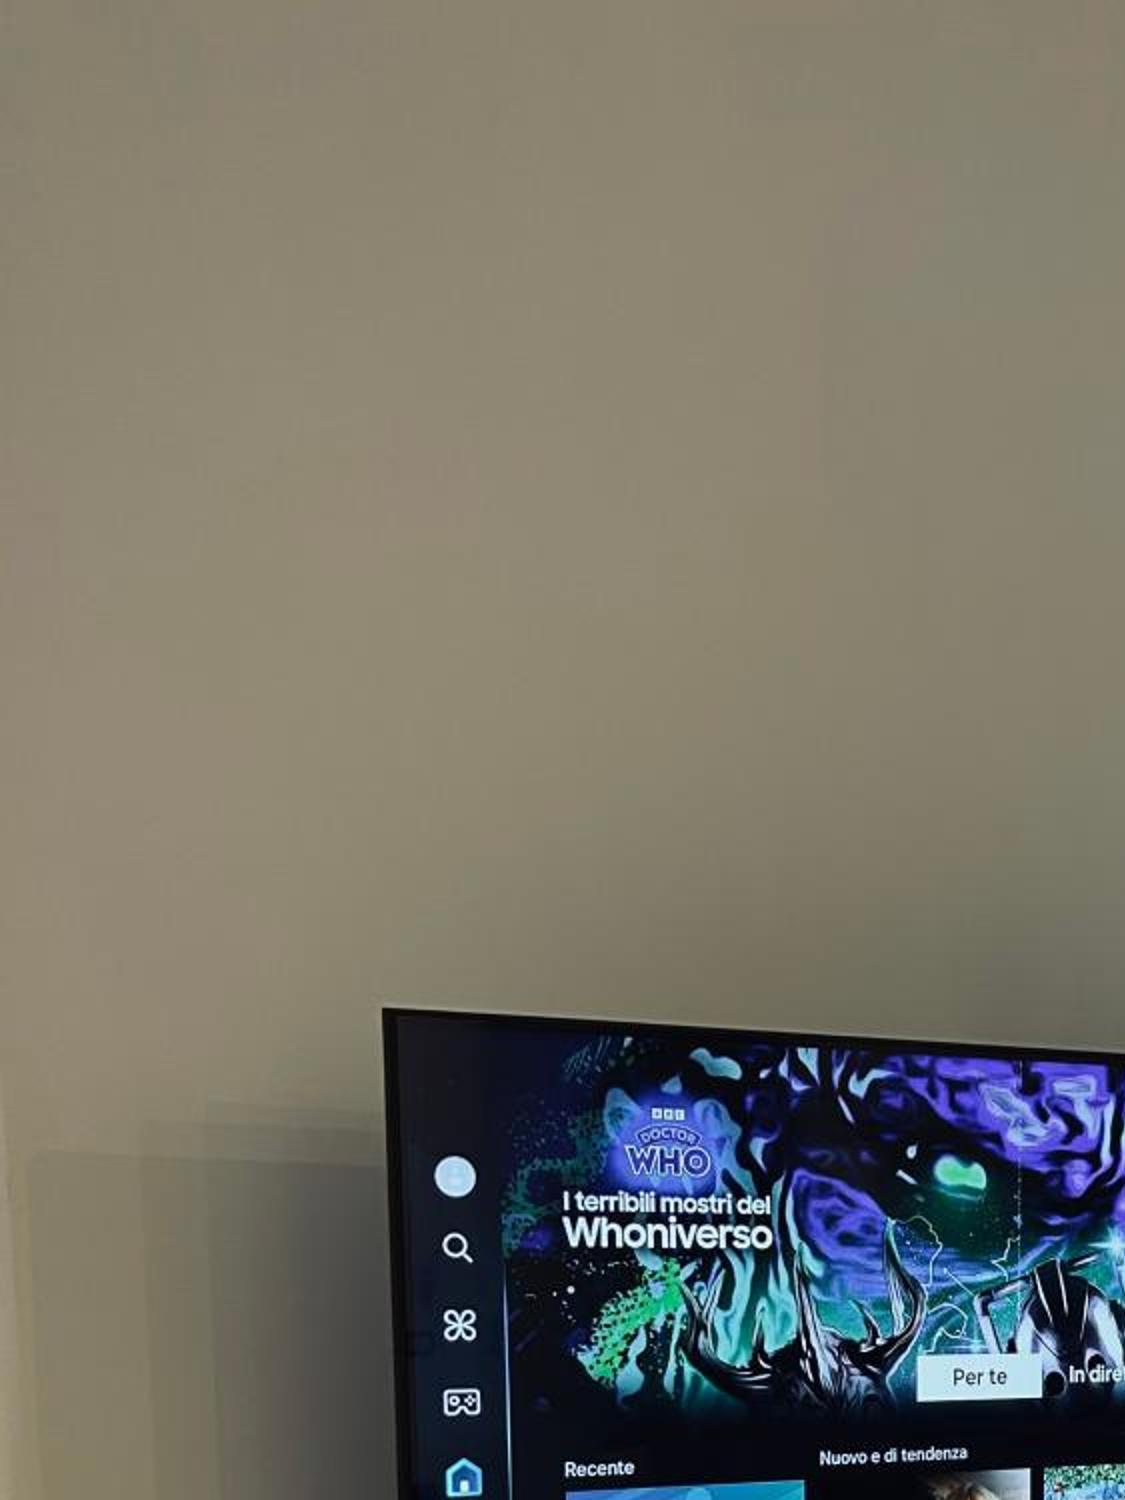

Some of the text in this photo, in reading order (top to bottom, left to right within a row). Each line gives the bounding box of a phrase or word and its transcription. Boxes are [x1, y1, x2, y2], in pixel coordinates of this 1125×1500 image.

[639, 1126, 699, 1145] DOCTOR
[624, 1144, 711, 1178] WHO
[563, 1191, 771, 1215] I terribili mostri del
[562, 1215, 773, 1249] Whoniverso
[952, 1367, 1007, 1386] Per te
[1069, 1365, 1085, 1383] In
[819, 1446, 968, 1466] Nuovo e di tendenza
[564, 1461, 635, 1478] Recente
